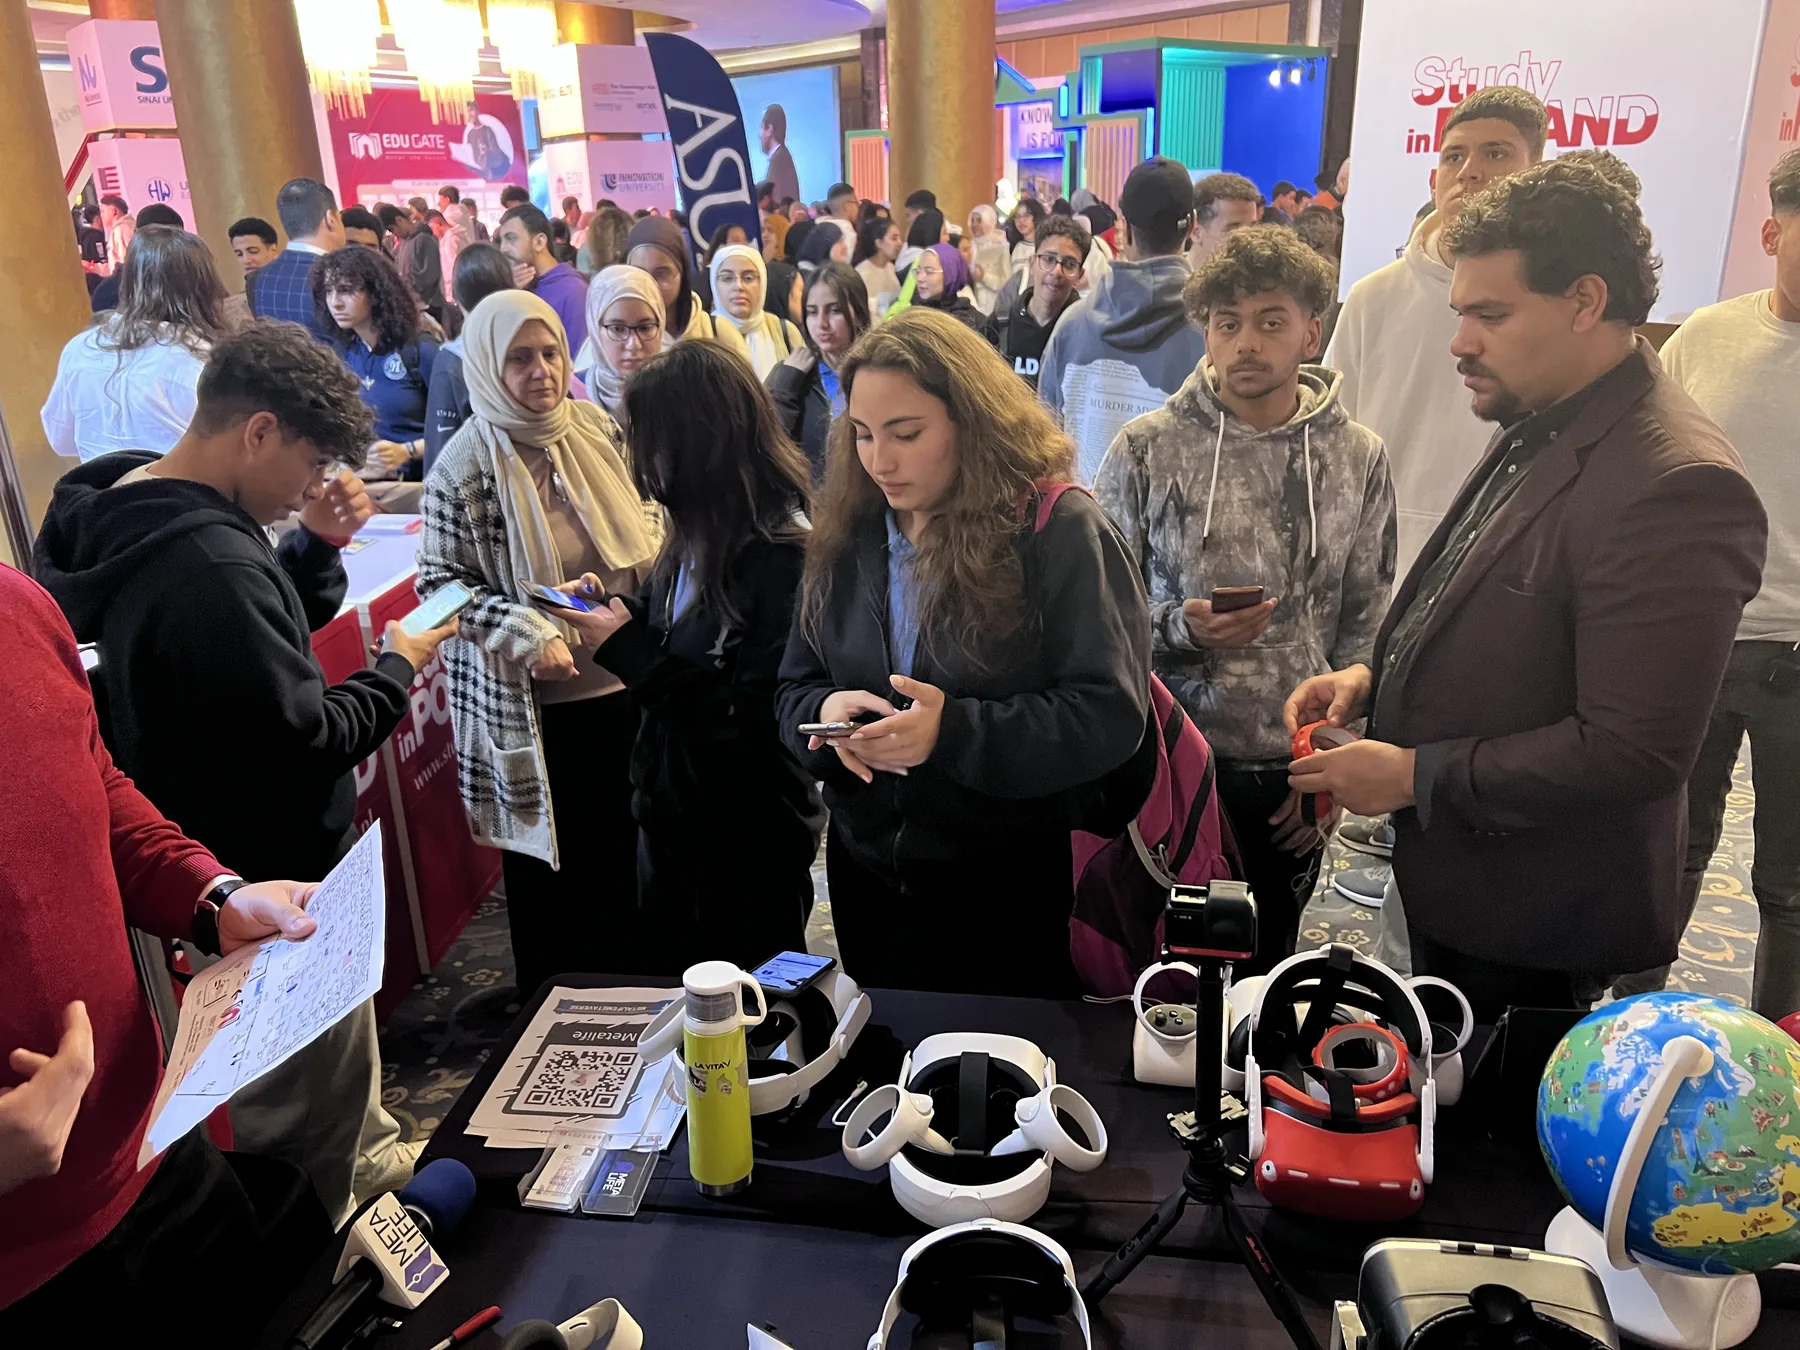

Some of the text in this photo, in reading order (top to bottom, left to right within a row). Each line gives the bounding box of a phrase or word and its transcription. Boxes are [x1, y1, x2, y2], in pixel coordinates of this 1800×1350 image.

[1411, 50, 1562, 106] Study
[137, 95, 161, 104] SINAI
[1027, 132, 1037, 149] IS
[1406, 129, 1431, 154] in
[1090, 397, 1134, 413] MURDER
[572, 1030, 638, 1042] Metalife
[602, 1172, 616, 1191] LIFE
[611, 1172, 628, 1197] META
[369, 1206, 413, 1267] META
[389, 1205, 427, 1253] LIFE
